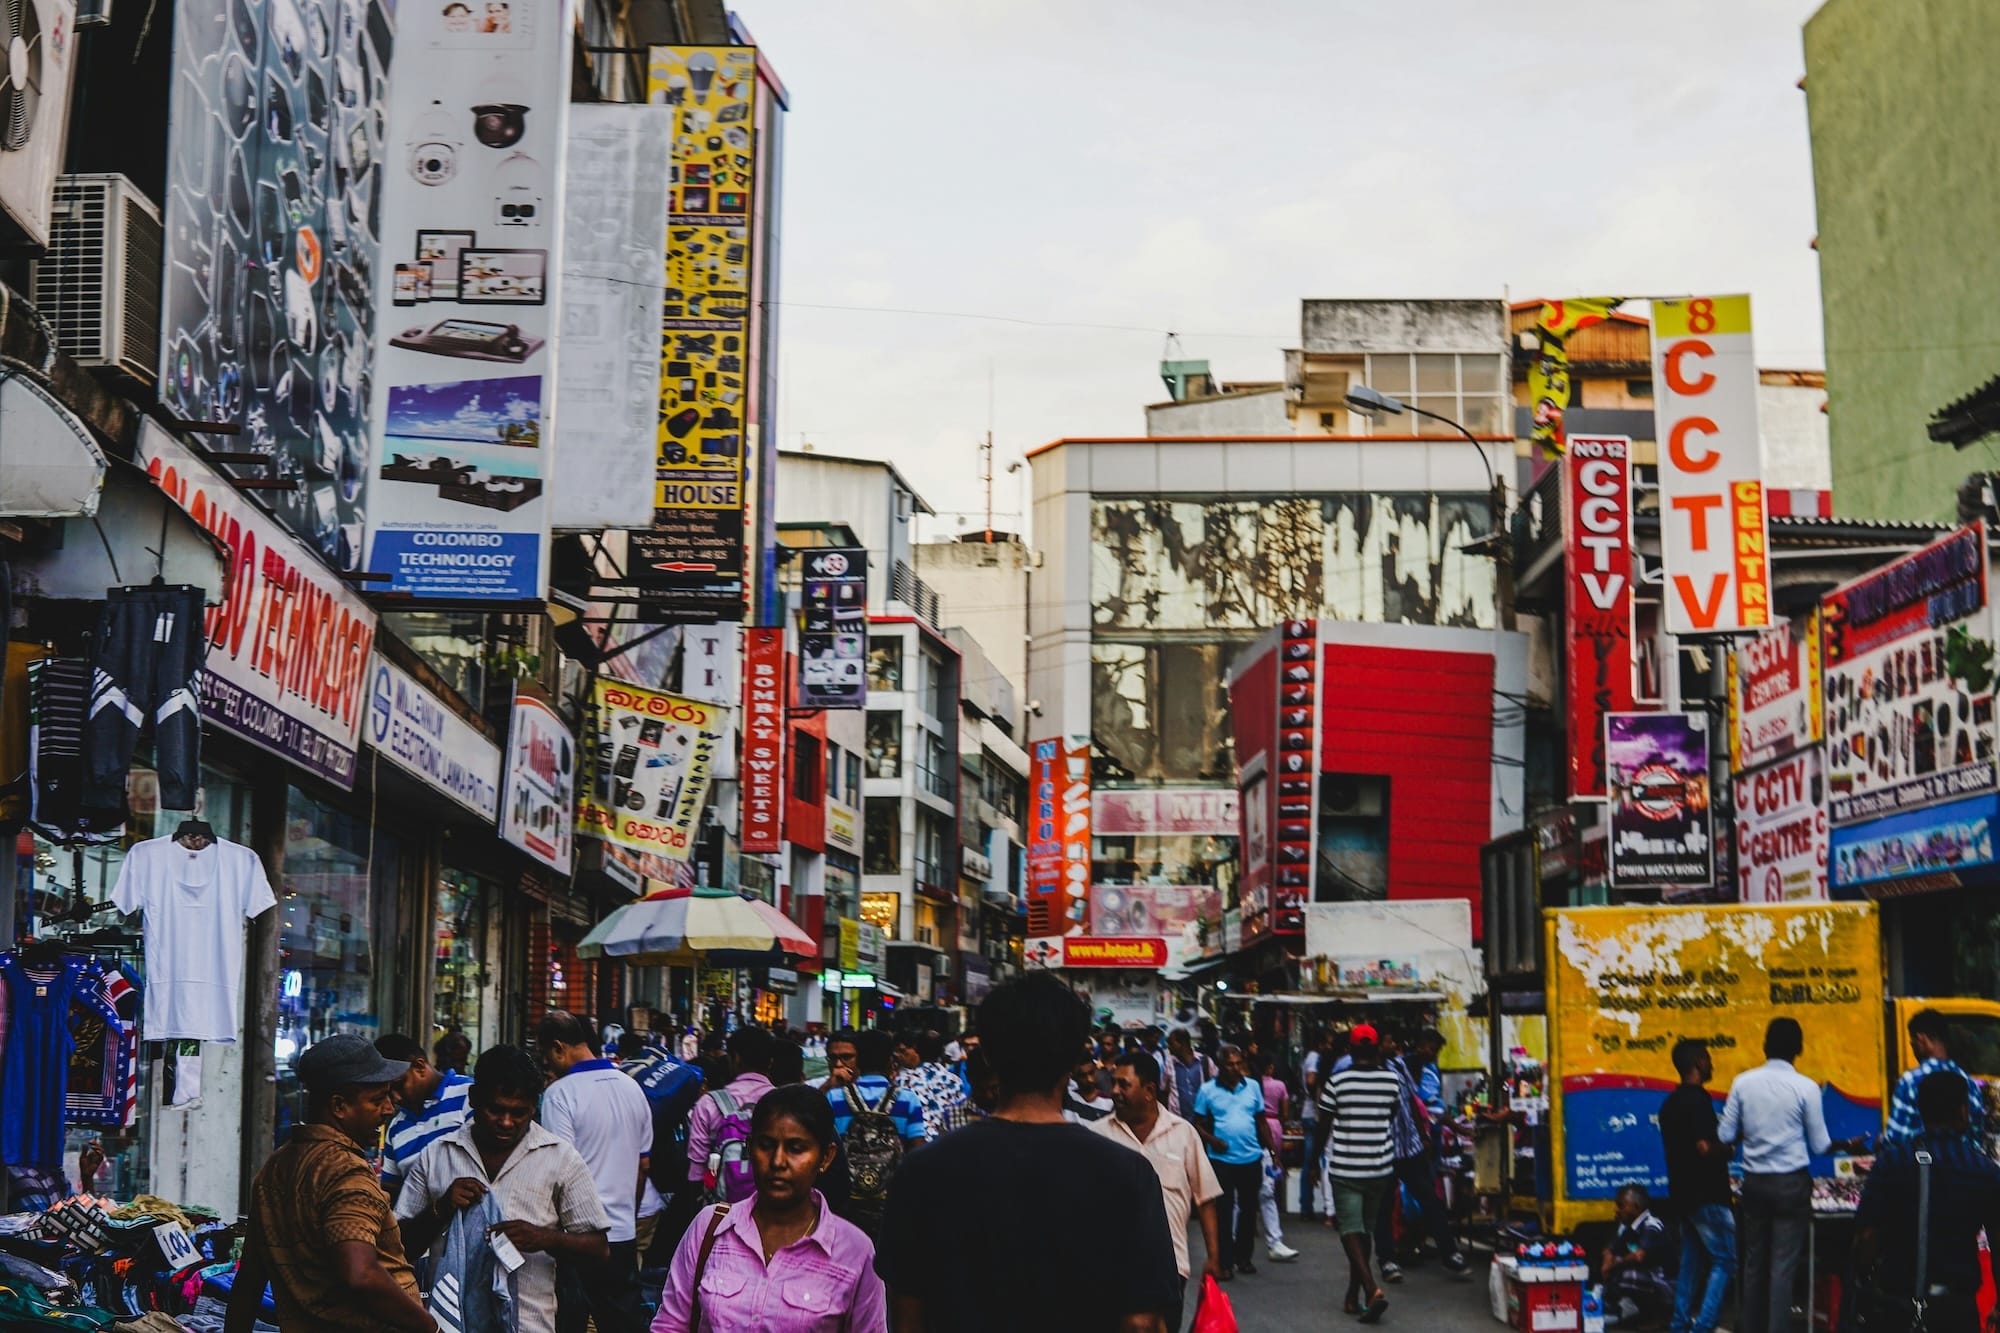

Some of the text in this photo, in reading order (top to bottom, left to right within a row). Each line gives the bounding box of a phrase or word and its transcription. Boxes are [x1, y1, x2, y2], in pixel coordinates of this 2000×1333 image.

[1687, 297, 1717, 336] 8
[1574, 441, 1626, 459] NO 12
[664, 485, 737, 505] HOUSE
[1664, 339, 1730, 629] CCTV
[398, 552, 516, 568] TECHNOLOGY
[413, 532, 503, 547] COLOMBO
[1579, 460, 1625, 610] CCTV
[1735, 481, 1767, 626] CENTRE
[250, 545, 373, 737] TECHNOLOGY
[751, 664, 777, 739] BOMBAY
[748, 747, 777, 823] SWEETS
[1036, 740, 1057, 840] MICRO
[1754, 758, 1805, 817] CCTV
[1675, 862, 1705, 876] WORKS
[1751, 817, 1812, 868] CENTRE
